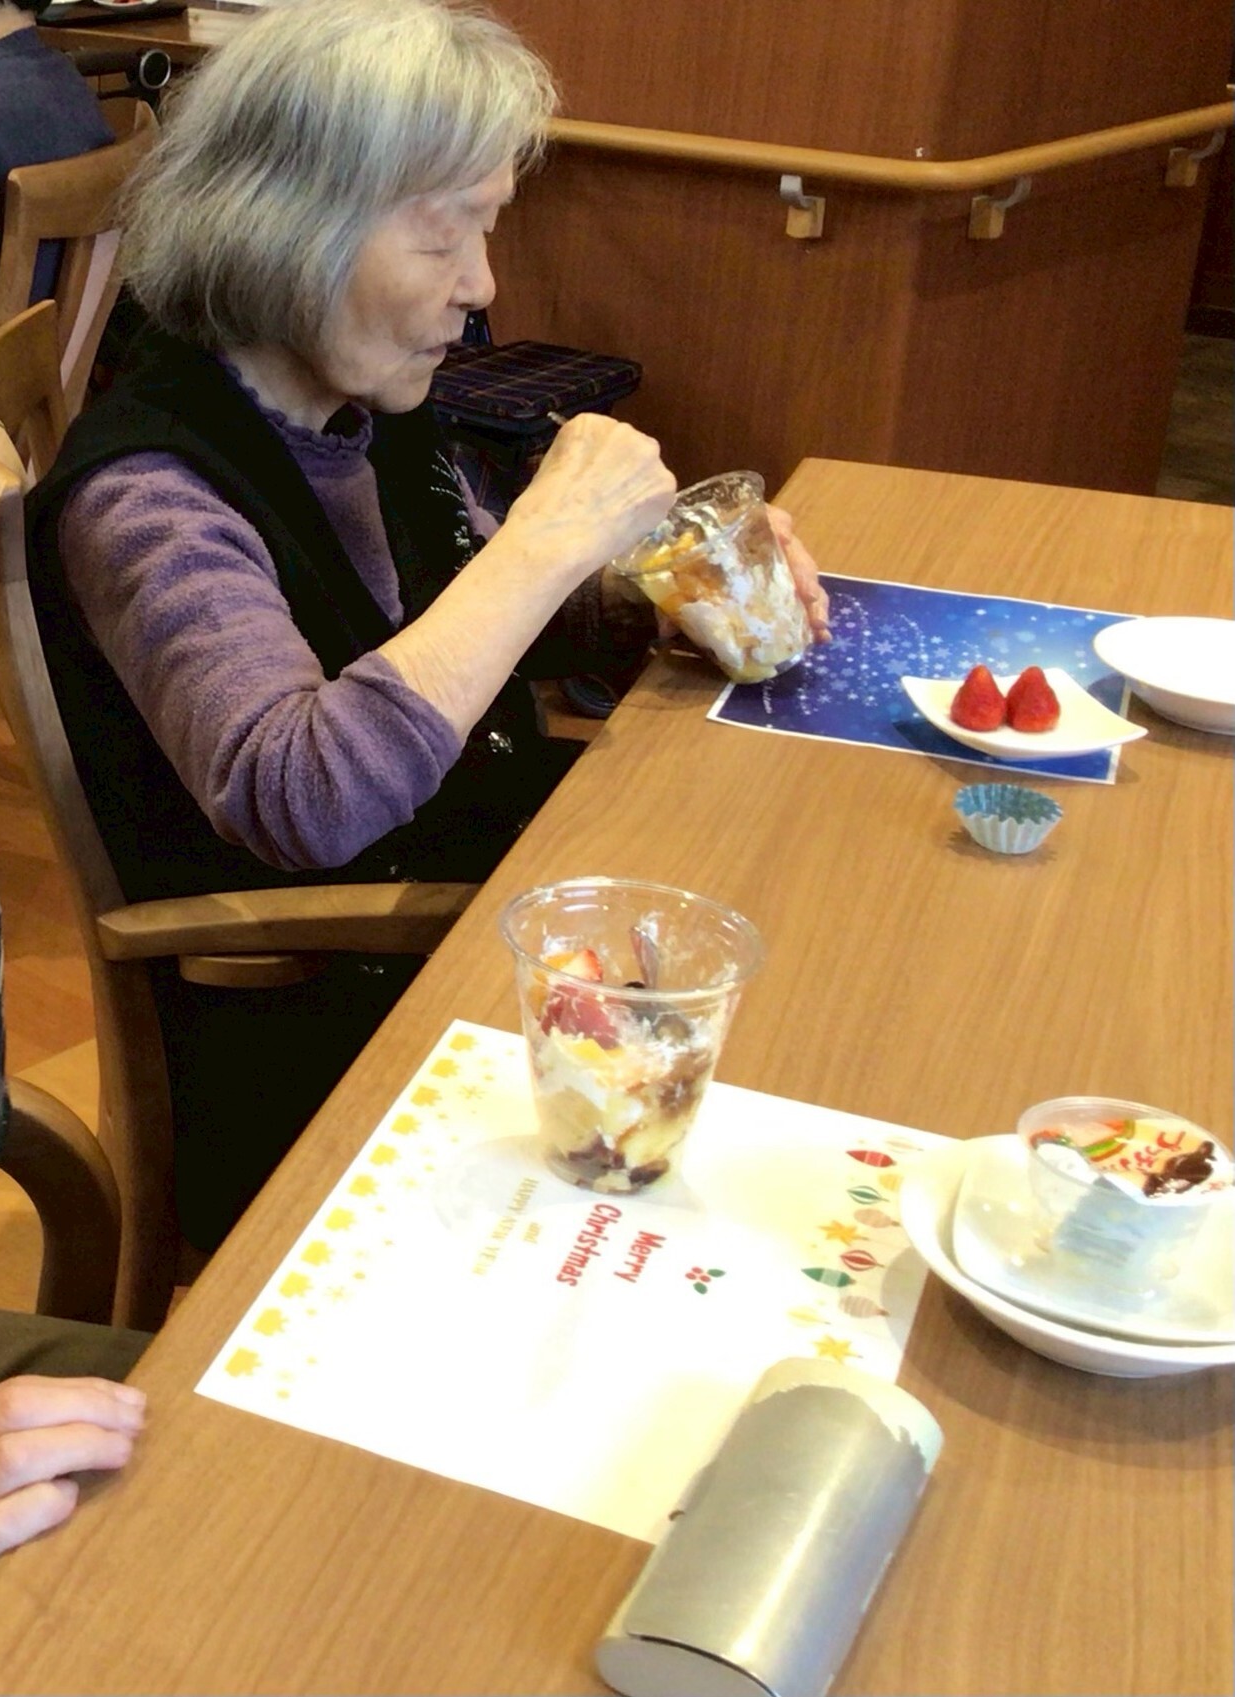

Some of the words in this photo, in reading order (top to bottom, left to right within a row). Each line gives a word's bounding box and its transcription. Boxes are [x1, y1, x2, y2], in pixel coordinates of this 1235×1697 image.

[508, 1177, 539, 1215] HAPPY
[492, 1215, 517, 1241] NEW
[556, 1203, 622, 1287] Christmas
[614, 1230, 666, 1283] Merry
